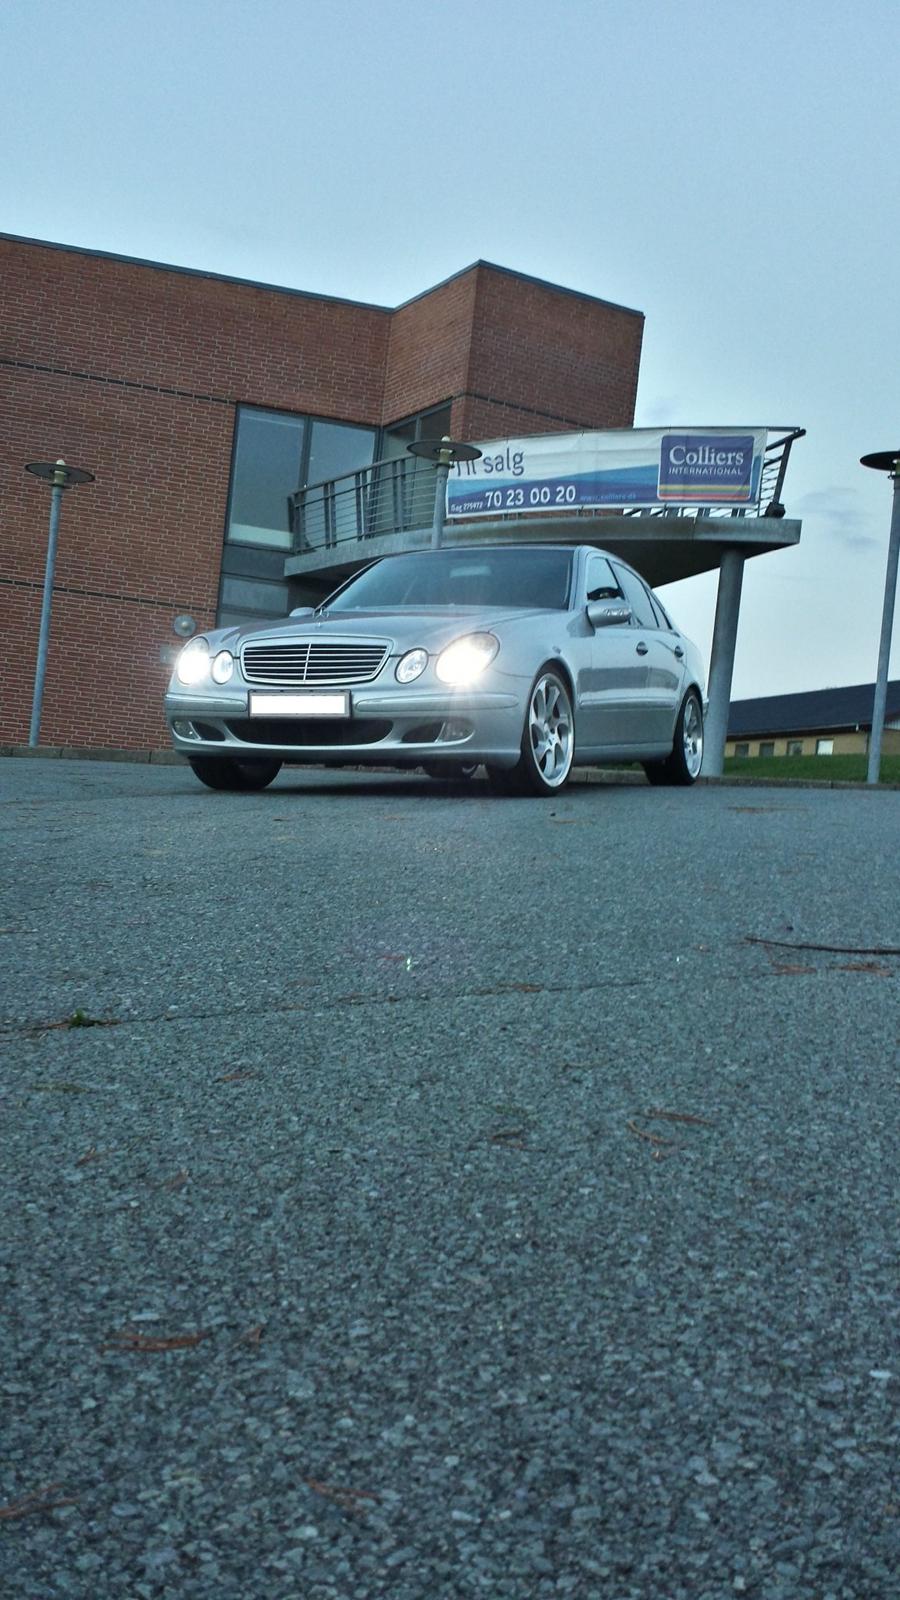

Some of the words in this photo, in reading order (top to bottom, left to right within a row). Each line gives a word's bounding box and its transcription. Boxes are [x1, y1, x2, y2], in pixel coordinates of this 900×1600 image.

[483, 448, 525, 476] salg
[669, 445, 744, 466] Colliers
[668, 466, 742, 476] INTERNATIONAL
[485, 491, 502, 508] 70
[506, 488, 524, 506] 23
[530, 486, 551, 504] 00
[555, 485, 576, 503] 20
